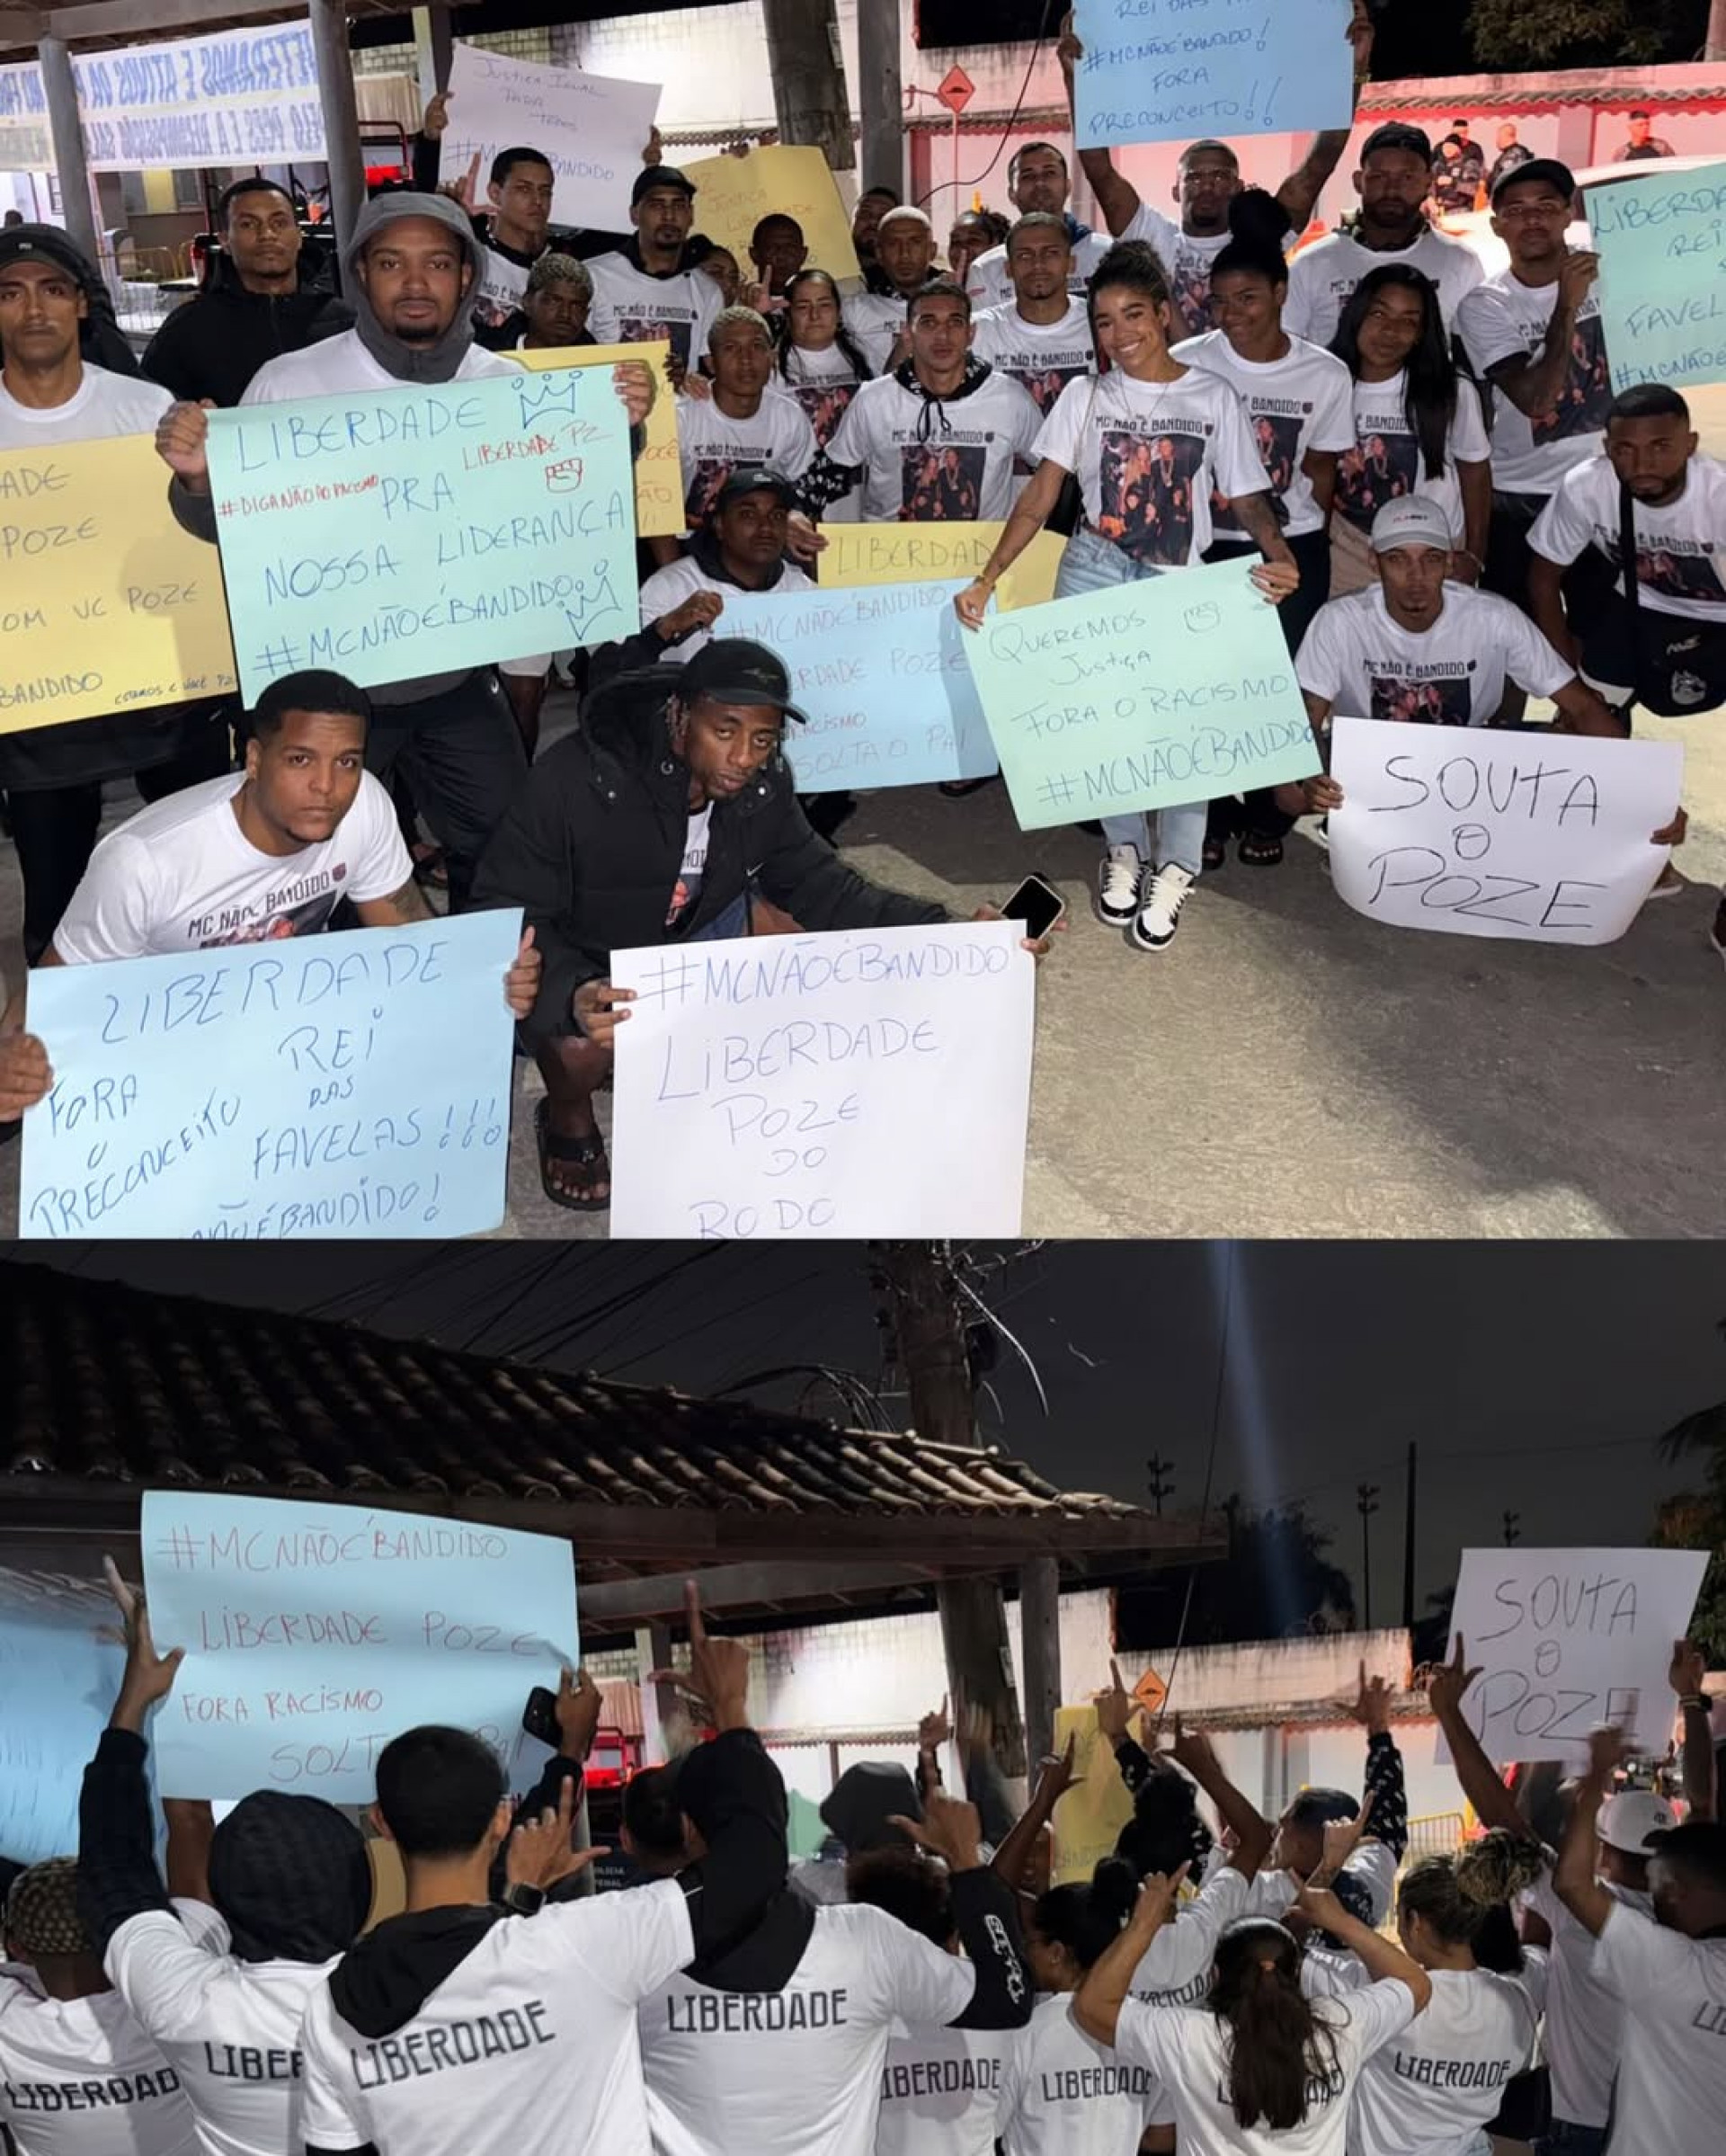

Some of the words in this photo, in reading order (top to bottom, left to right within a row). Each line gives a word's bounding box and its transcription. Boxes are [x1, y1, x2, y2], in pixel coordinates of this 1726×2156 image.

[1152, 67, 1211, 93] FORA
[237, 396, 488, 472] LIBERDADE
[461, 434, 560, 470] LIBERDADE
[382, 474, 454, 520] PRA
[2, 517, 100, 559] POZE
[264, 543, 403, 606] NOSSA
[437, 489, 626, 566] LIDERANÇA
[838, 534, 993, 577] LIBERDAD
[127, 582, 200, 614] POZE
[1415, 661, 1465, 679] BANDIDO
[1012, 701, 1099, 740] FORA
[1115, 698, 1137, 719] O
[1141, 675, 1290, 712] RACISMO
[1367, 845, 1610, 930] POZE
[188, 915, 215, 939] MC
[278, 1006, 385, 1074] REI
[657, 1018, 939, 1101] LIBERDADE
[49, 1074, 138, 1139] FORA
[308, 1076, 355, 1111] DAS
[710, 1092, 860, 1145] POZE
[200, 1605, 389, 1652] LIBERDADE
[422, 1609, 541, 1657] POZE
[182, 1692, 249, 1724] FORA
[266, 1684, 384, 1716] RACISMO
[270, 1731, 389, 1784] SOLT
[667, 1989, 848, 2033] LIBERDADE
[350, 2000, 556, 2089] LIBERDADE
[4, 2067, 180, 2112] LIBERDAD
[1394, 2051, 1511, 2088] LIBERDADE
